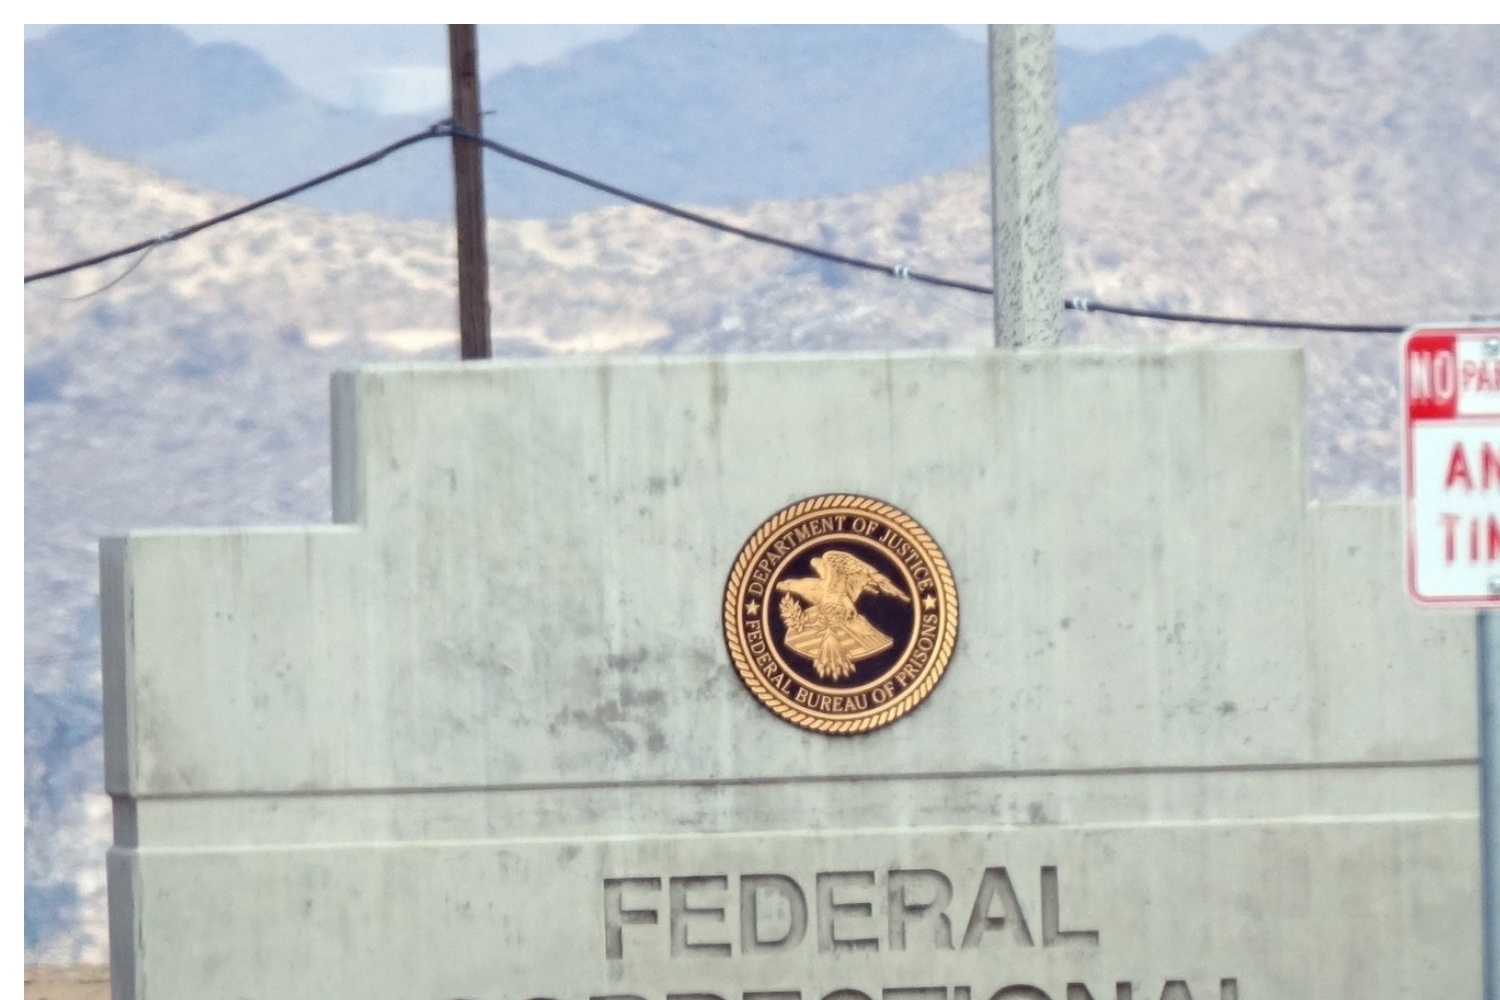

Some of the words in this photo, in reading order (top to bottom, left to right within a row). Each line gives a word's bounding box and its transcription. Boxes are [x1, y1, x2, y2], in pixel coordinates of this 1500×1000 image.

[1411, 350, 1455, 405] NO
[750, 516, 846, 596] DEPARTMENT
[853, 517, 879, 536] OF
[879, 529, 935, 592] JUSTICE
[745, 619, 797, 695] FEDERAL
[796, 689, 868, 713] BUREAU
[872, 683, 897, 704] OF
[896, 613, 938, 687] PRISONS
[603, 865, 1100, 960] FEDERAL
